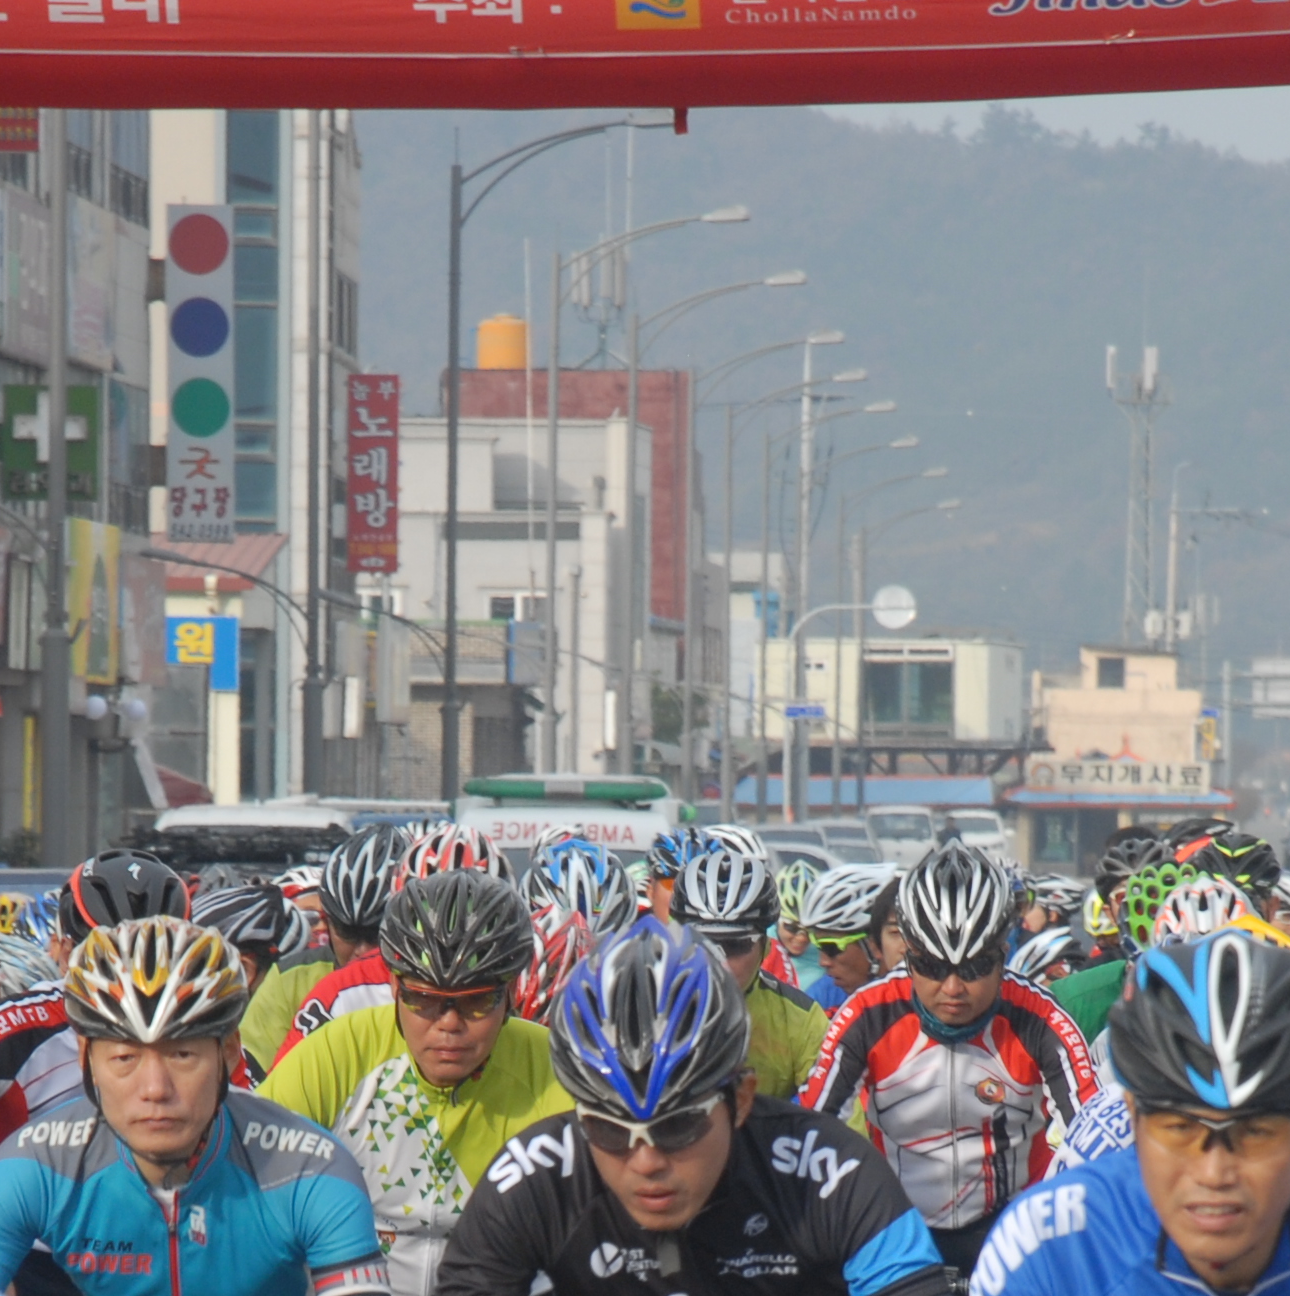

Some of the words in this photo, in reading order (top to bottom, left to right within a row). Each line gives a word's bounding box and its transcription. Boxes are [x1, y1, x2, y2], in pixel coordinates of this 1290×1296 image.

[724, 6, 918, 24] ChollaNamdo
[351, 406, 395, 528] 노래방
[169, 487, 230, 518] 당구장
[173, 621, 215, 665] 원
[1060, 764, 1202, 787] 무지개사료
[242, 1121, 336, 1161] POWER
[486, 1122, 575, 1194] sky
[771, 1129, 860, 1199] sky
[81, 1237, 134, 1253] TEAM
[66, 1251, 153, 1277] POWER
